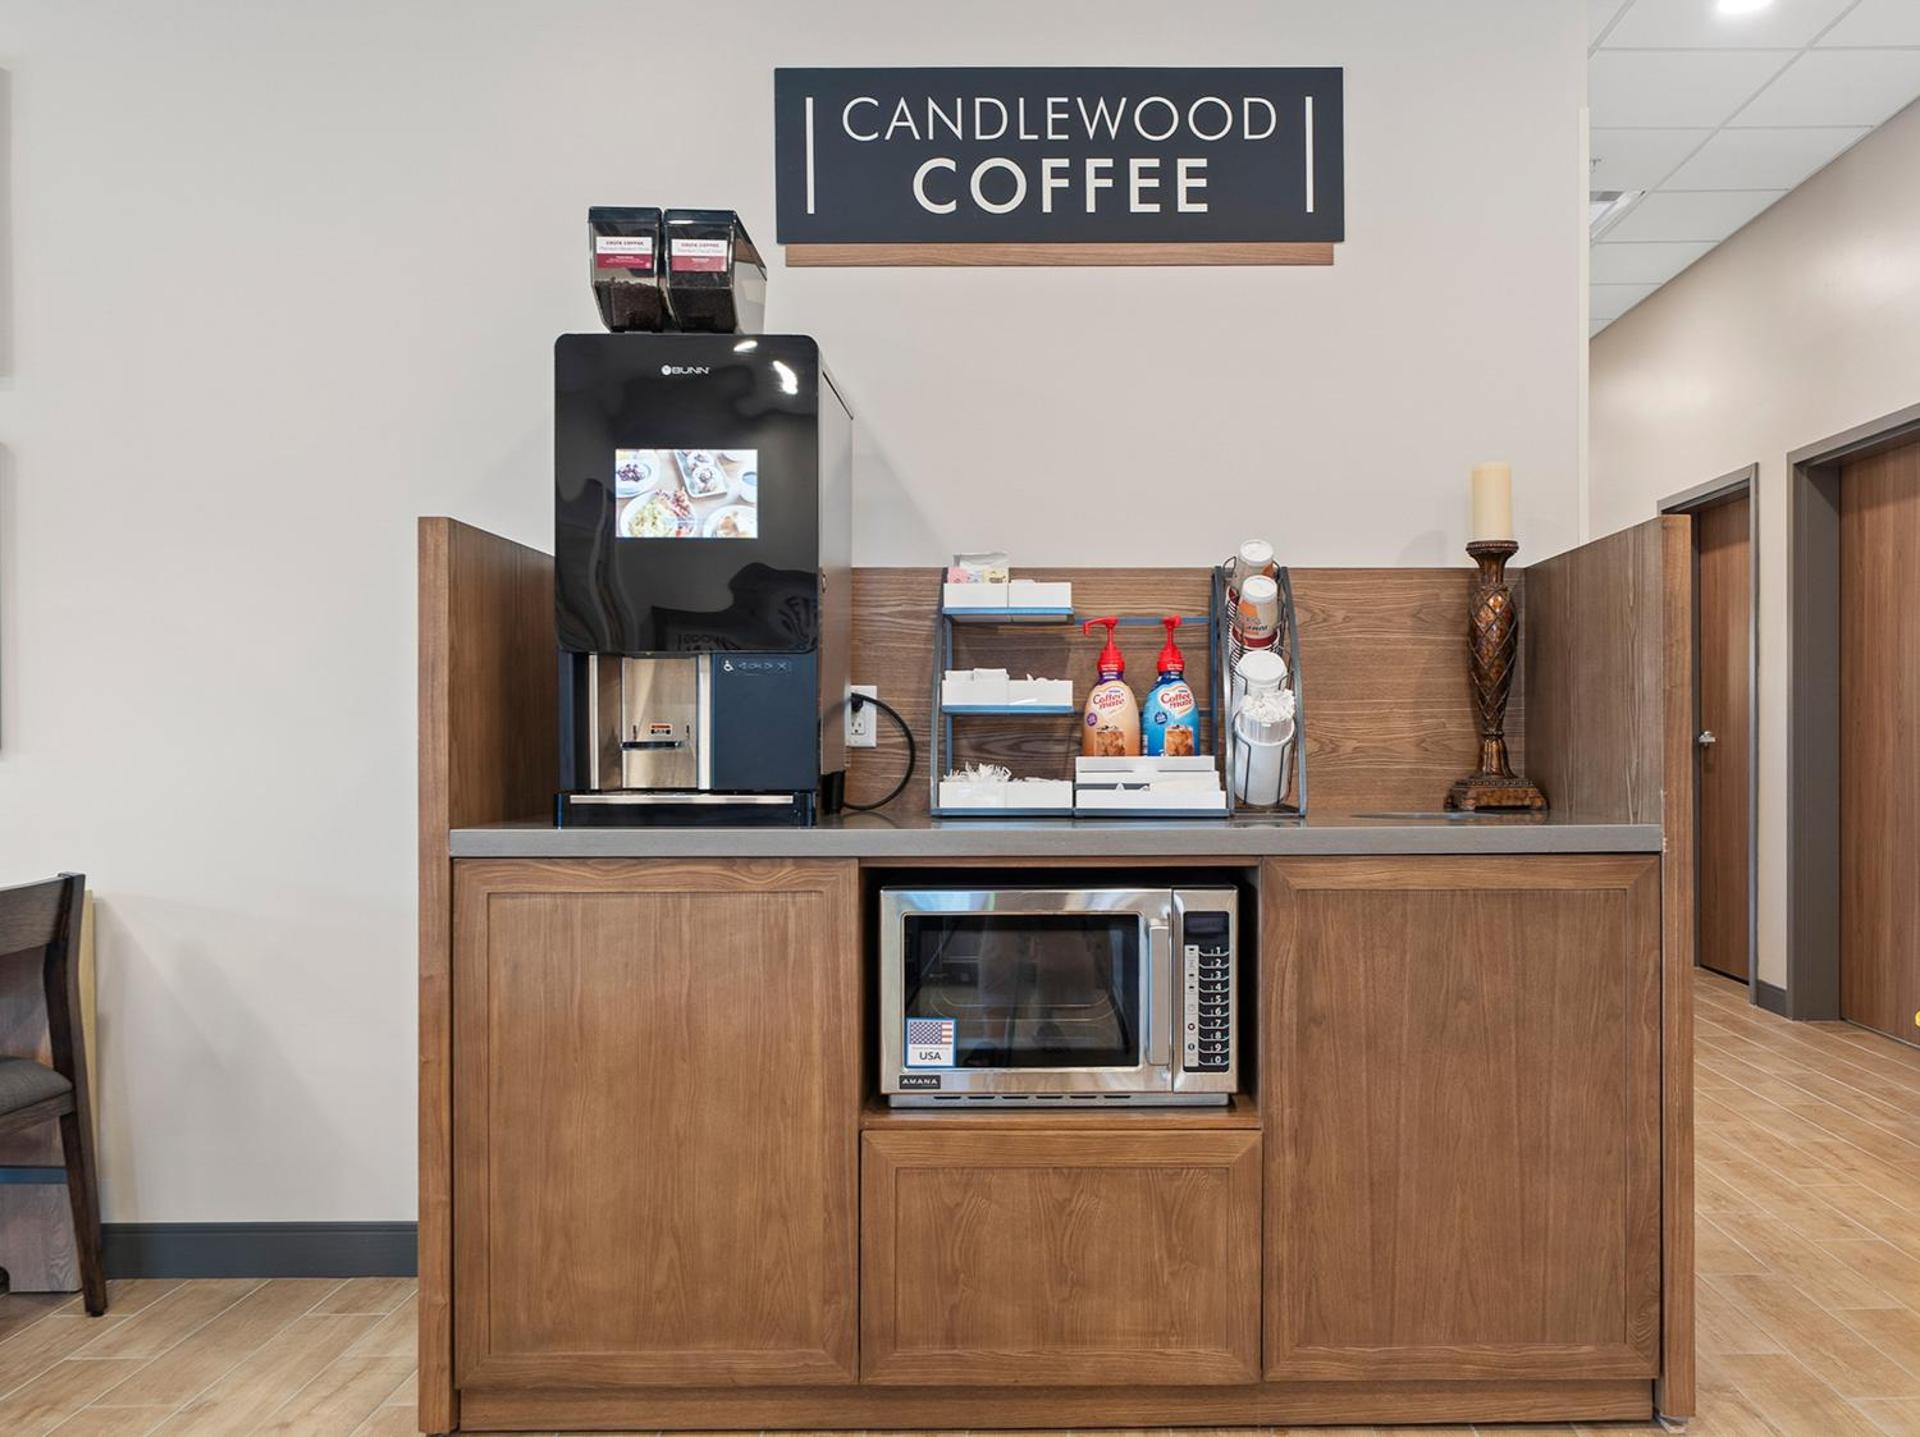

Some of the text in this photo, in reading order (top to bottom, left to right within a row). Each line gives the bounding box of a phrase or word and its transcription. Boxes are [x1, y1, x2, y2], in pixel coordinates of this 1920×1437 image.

[842, 96, 1277, 142] CANDLEWOOD
[912, 157, 1209, 215] COFFEE
[671, 366, 710, 375] BUNN
[1093, 692, 1121, 705] Coffee
[919, 1052, 942, 1060] USA
